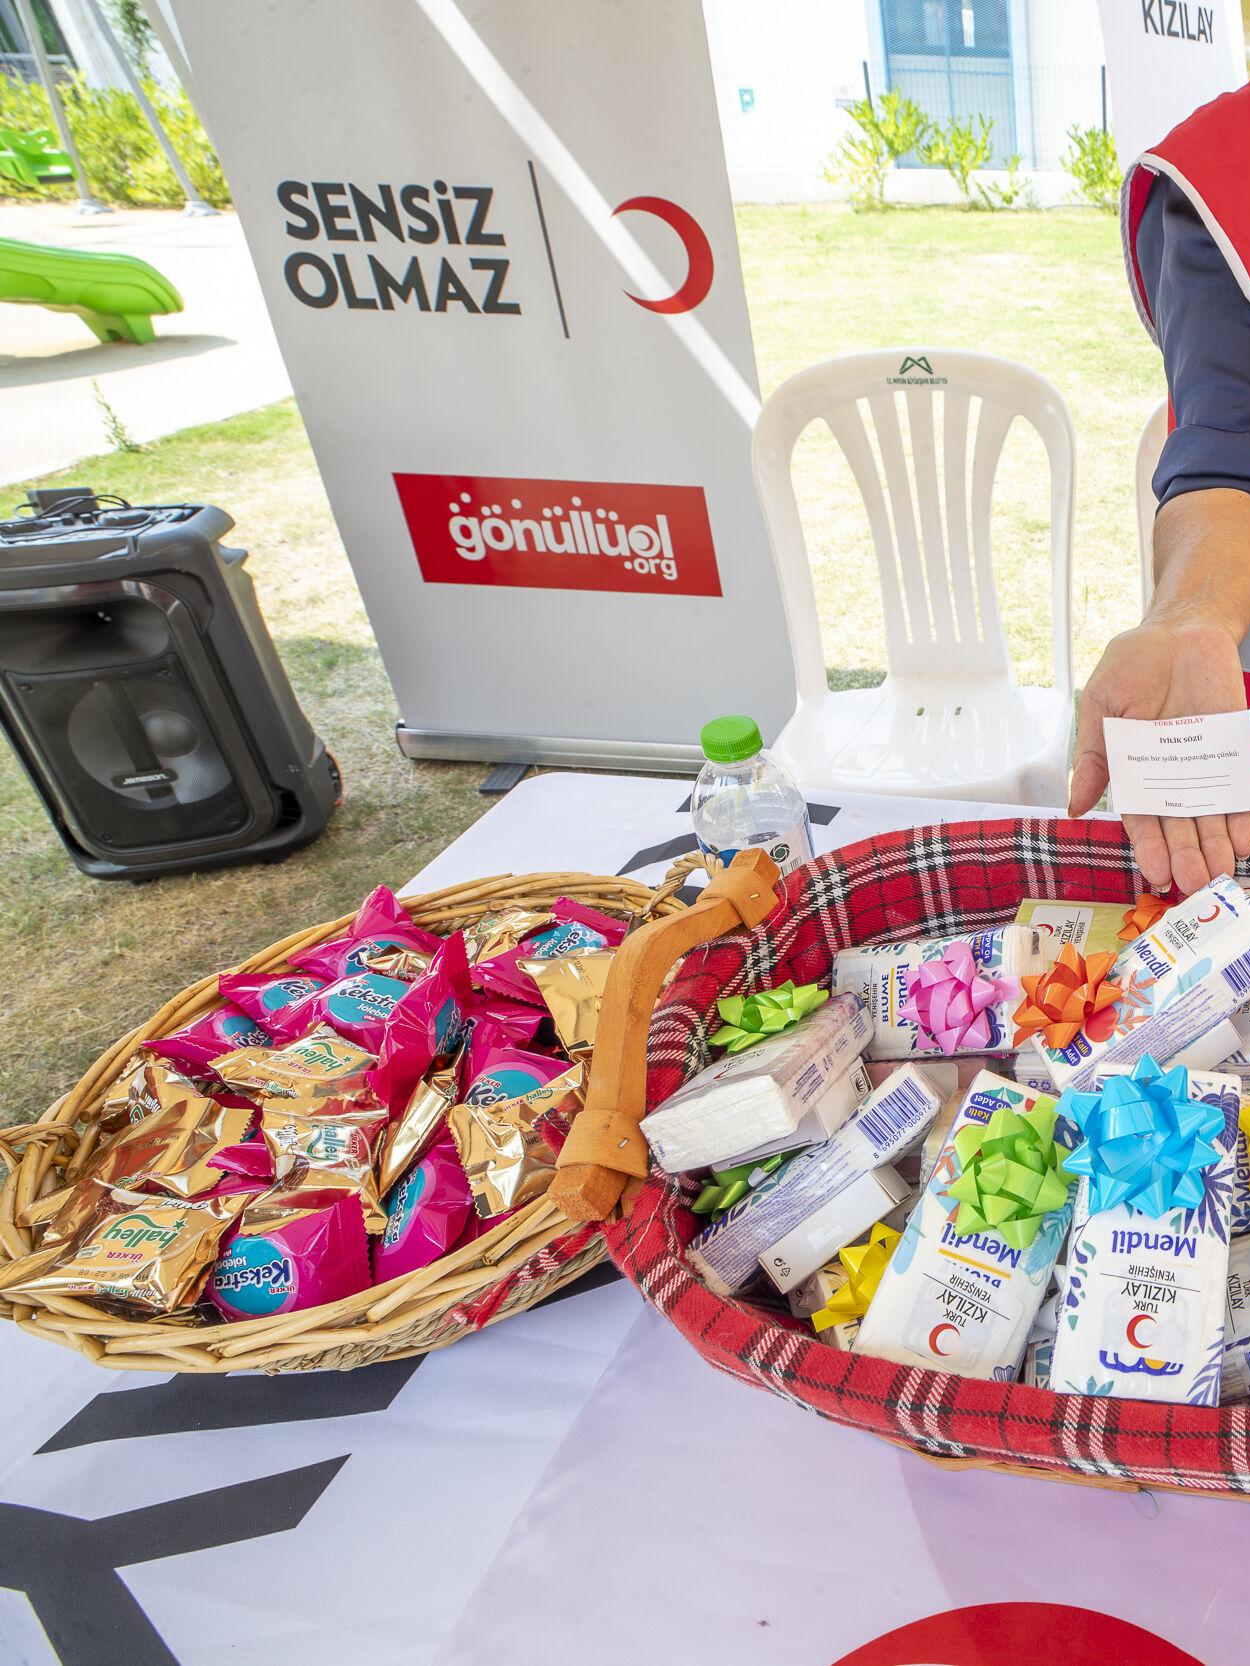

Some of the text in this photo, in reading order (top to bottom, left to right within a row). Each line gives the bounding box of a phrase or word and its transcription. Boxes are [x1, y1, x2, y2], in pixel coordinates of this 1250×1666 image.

[1142, 0, 1213, 44] KIZILAY
[284, 251, 522, 315] OLMAZ
[1128, 755, 1150, 763] Bugün
[1162, 755, 1179, 763] iyilik
[1180, 752, 1216, 763] yapacağım
[1060, 919, 1075, 945] KIZILAY
[1173, 918, 1200, 943] KIZILAY
[1132, 938, 1173, 979] Mendil
[1065, 1049, 1078, 1064] Adet
[477, 1074, 501, 1088] ÜLKER
[968, 1107, 990, 1119] Katlı
[974, 1094, 994, 1106] Adet
[873, 1103, 932, 1160] 8 695077 000972
[102, 1218, 179, 1250] halley
[940, 1221, 1022, 1269] Mendil
[1111, 1230, 1197, 1258] Mendil
[106, 1251, 144, 1264] ÜLKER
[214, 1257, 293, 1292] Kekstra
[1128, 1264, 1176, 1282] YENİŞEHİR
[950, 1273, 991, 1303] YENİŞEHİR
[1121, 1281, 1177, 1304] KIZILAY
[1227, 1273, 1245, 1311] KIZILAY
[936, 1289, 988, 1324] KIZILAY
